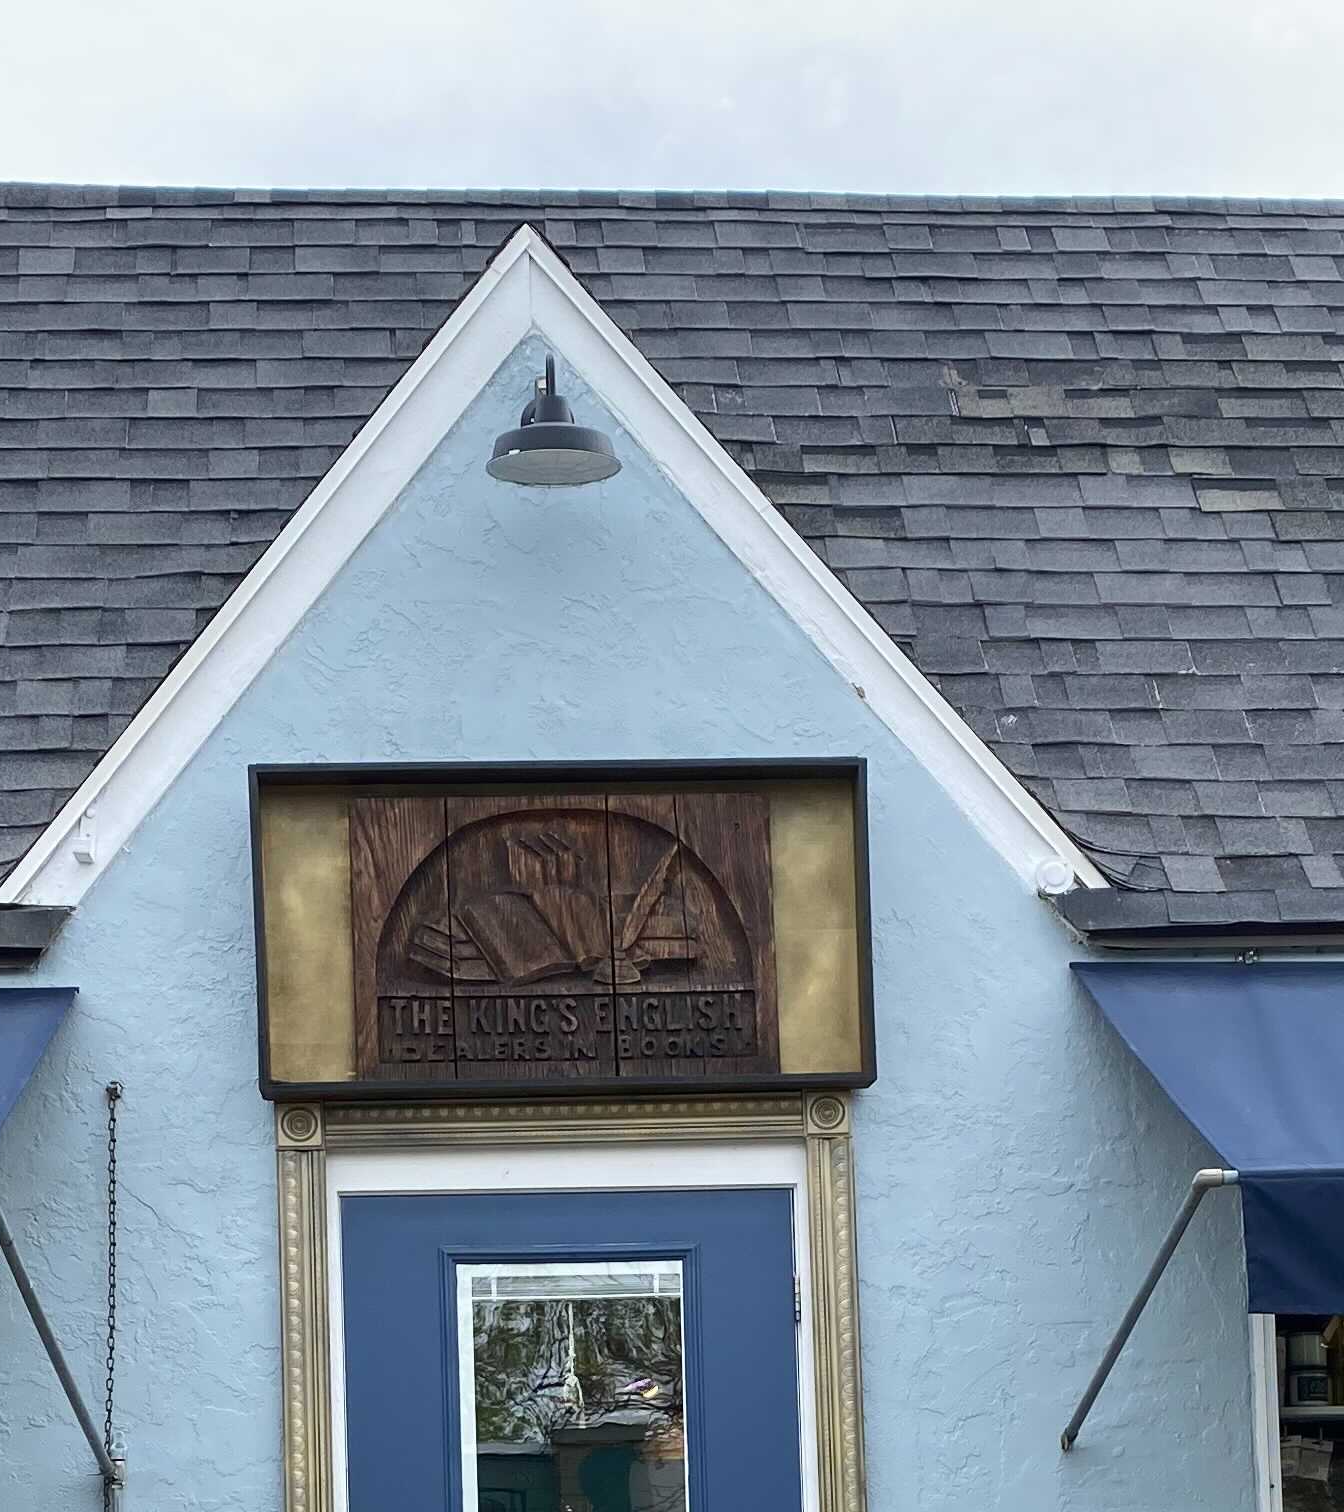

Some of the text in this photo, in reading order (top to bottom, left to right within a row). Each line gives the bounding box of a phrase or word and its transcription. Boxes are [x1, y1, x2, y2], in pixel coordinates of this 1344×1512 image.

[389, 993, 744, 1035] THE KING'S ENGLISH
[619, 1035, 726, 1059] BOOKS
